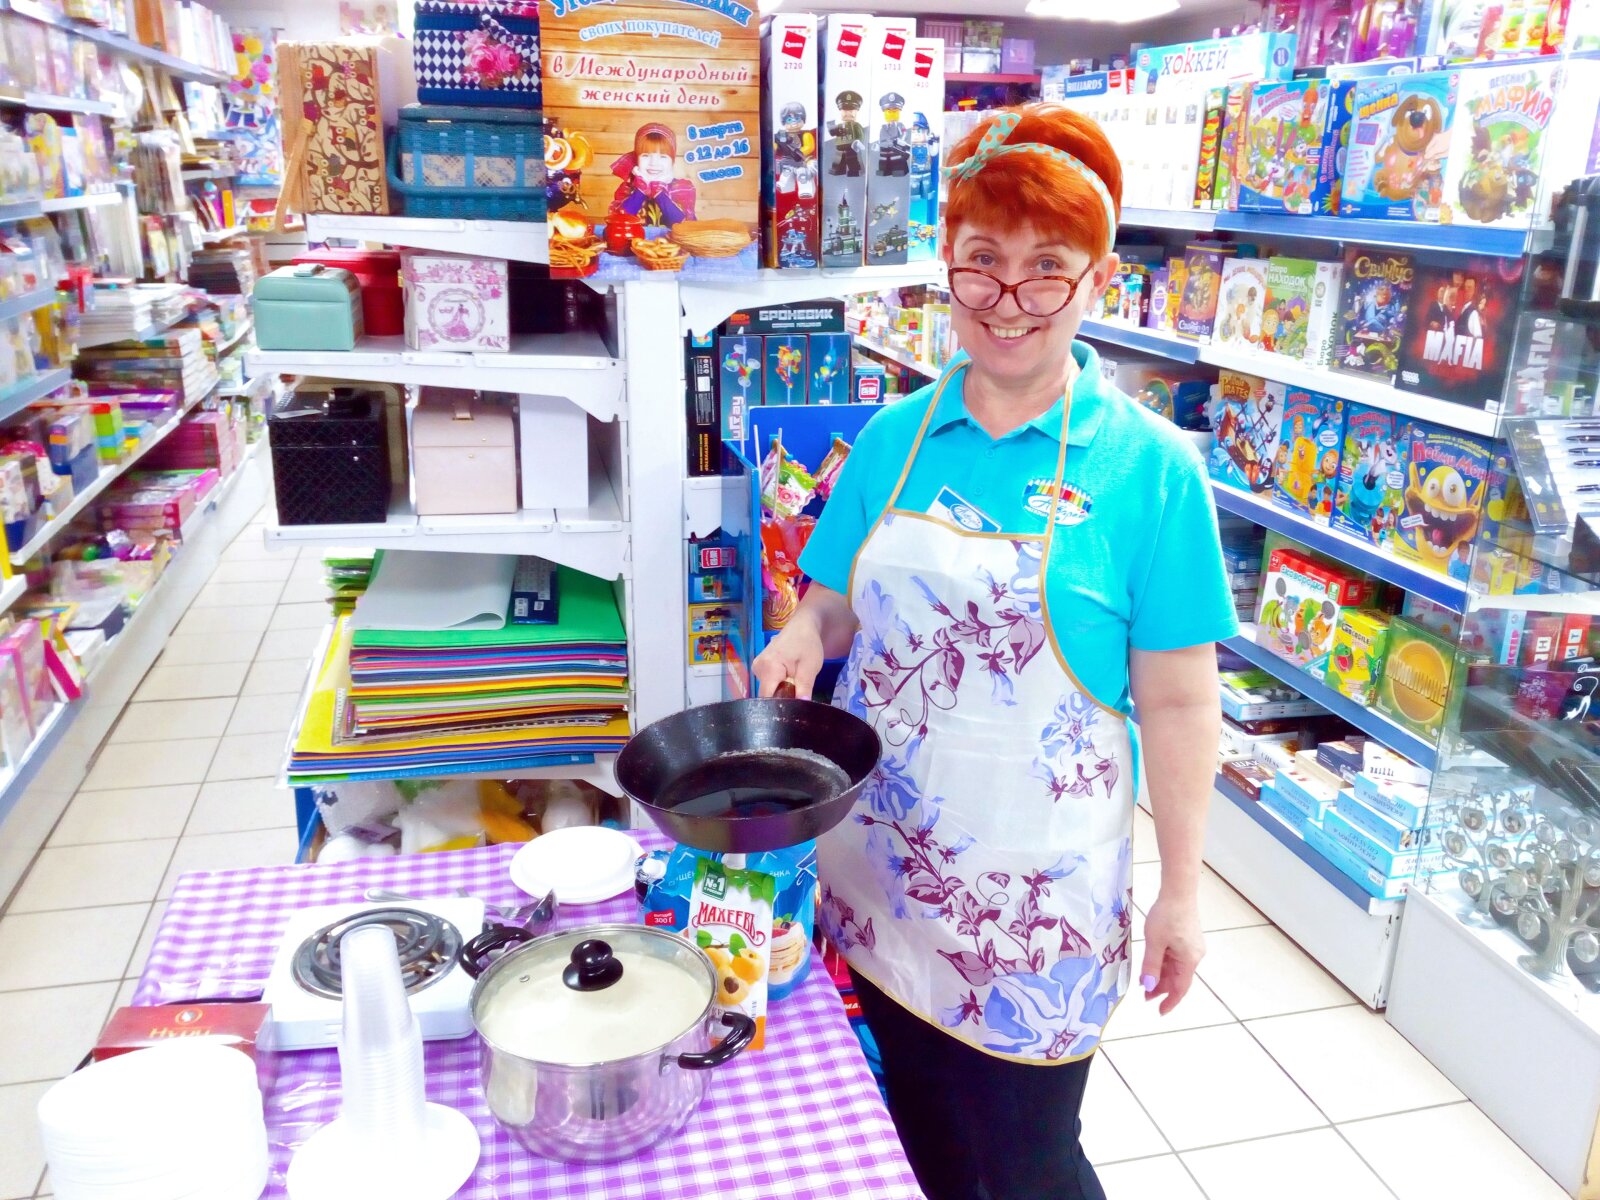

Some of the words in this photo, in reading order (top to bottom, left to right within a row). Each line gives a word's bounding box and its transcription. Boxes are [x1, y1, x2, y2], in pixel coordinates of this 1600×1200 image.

[581, 21, 623, 40] своих
[626, 20, 720, 47] покупателей
[553, 55, 563, 74] в
[565, 56, 748, 82] Международный
[784, 62, 803, 70] 2720
[1066, 79, 1104, 92] BILLIARDS
[582, 88, 671, 105] женский
[677, 87, 720, 106] день
[1474, 85, 1553, 127] МАФИЯ
[688, 126, 697, 140] 8
[699, 122, 743, 139] марта
[696, 145, 712, 161] 12
[714, 146, 731, 160] до
[733, 139, 749, 155] 16
[1269, 263, 1288, 274] Бюро
[1267, 273, 1307, 287] НАХОДОК
[759, 308, 834, 321] БРОНЕВИК
[1423, 323, 1484, 371] MAFIA
